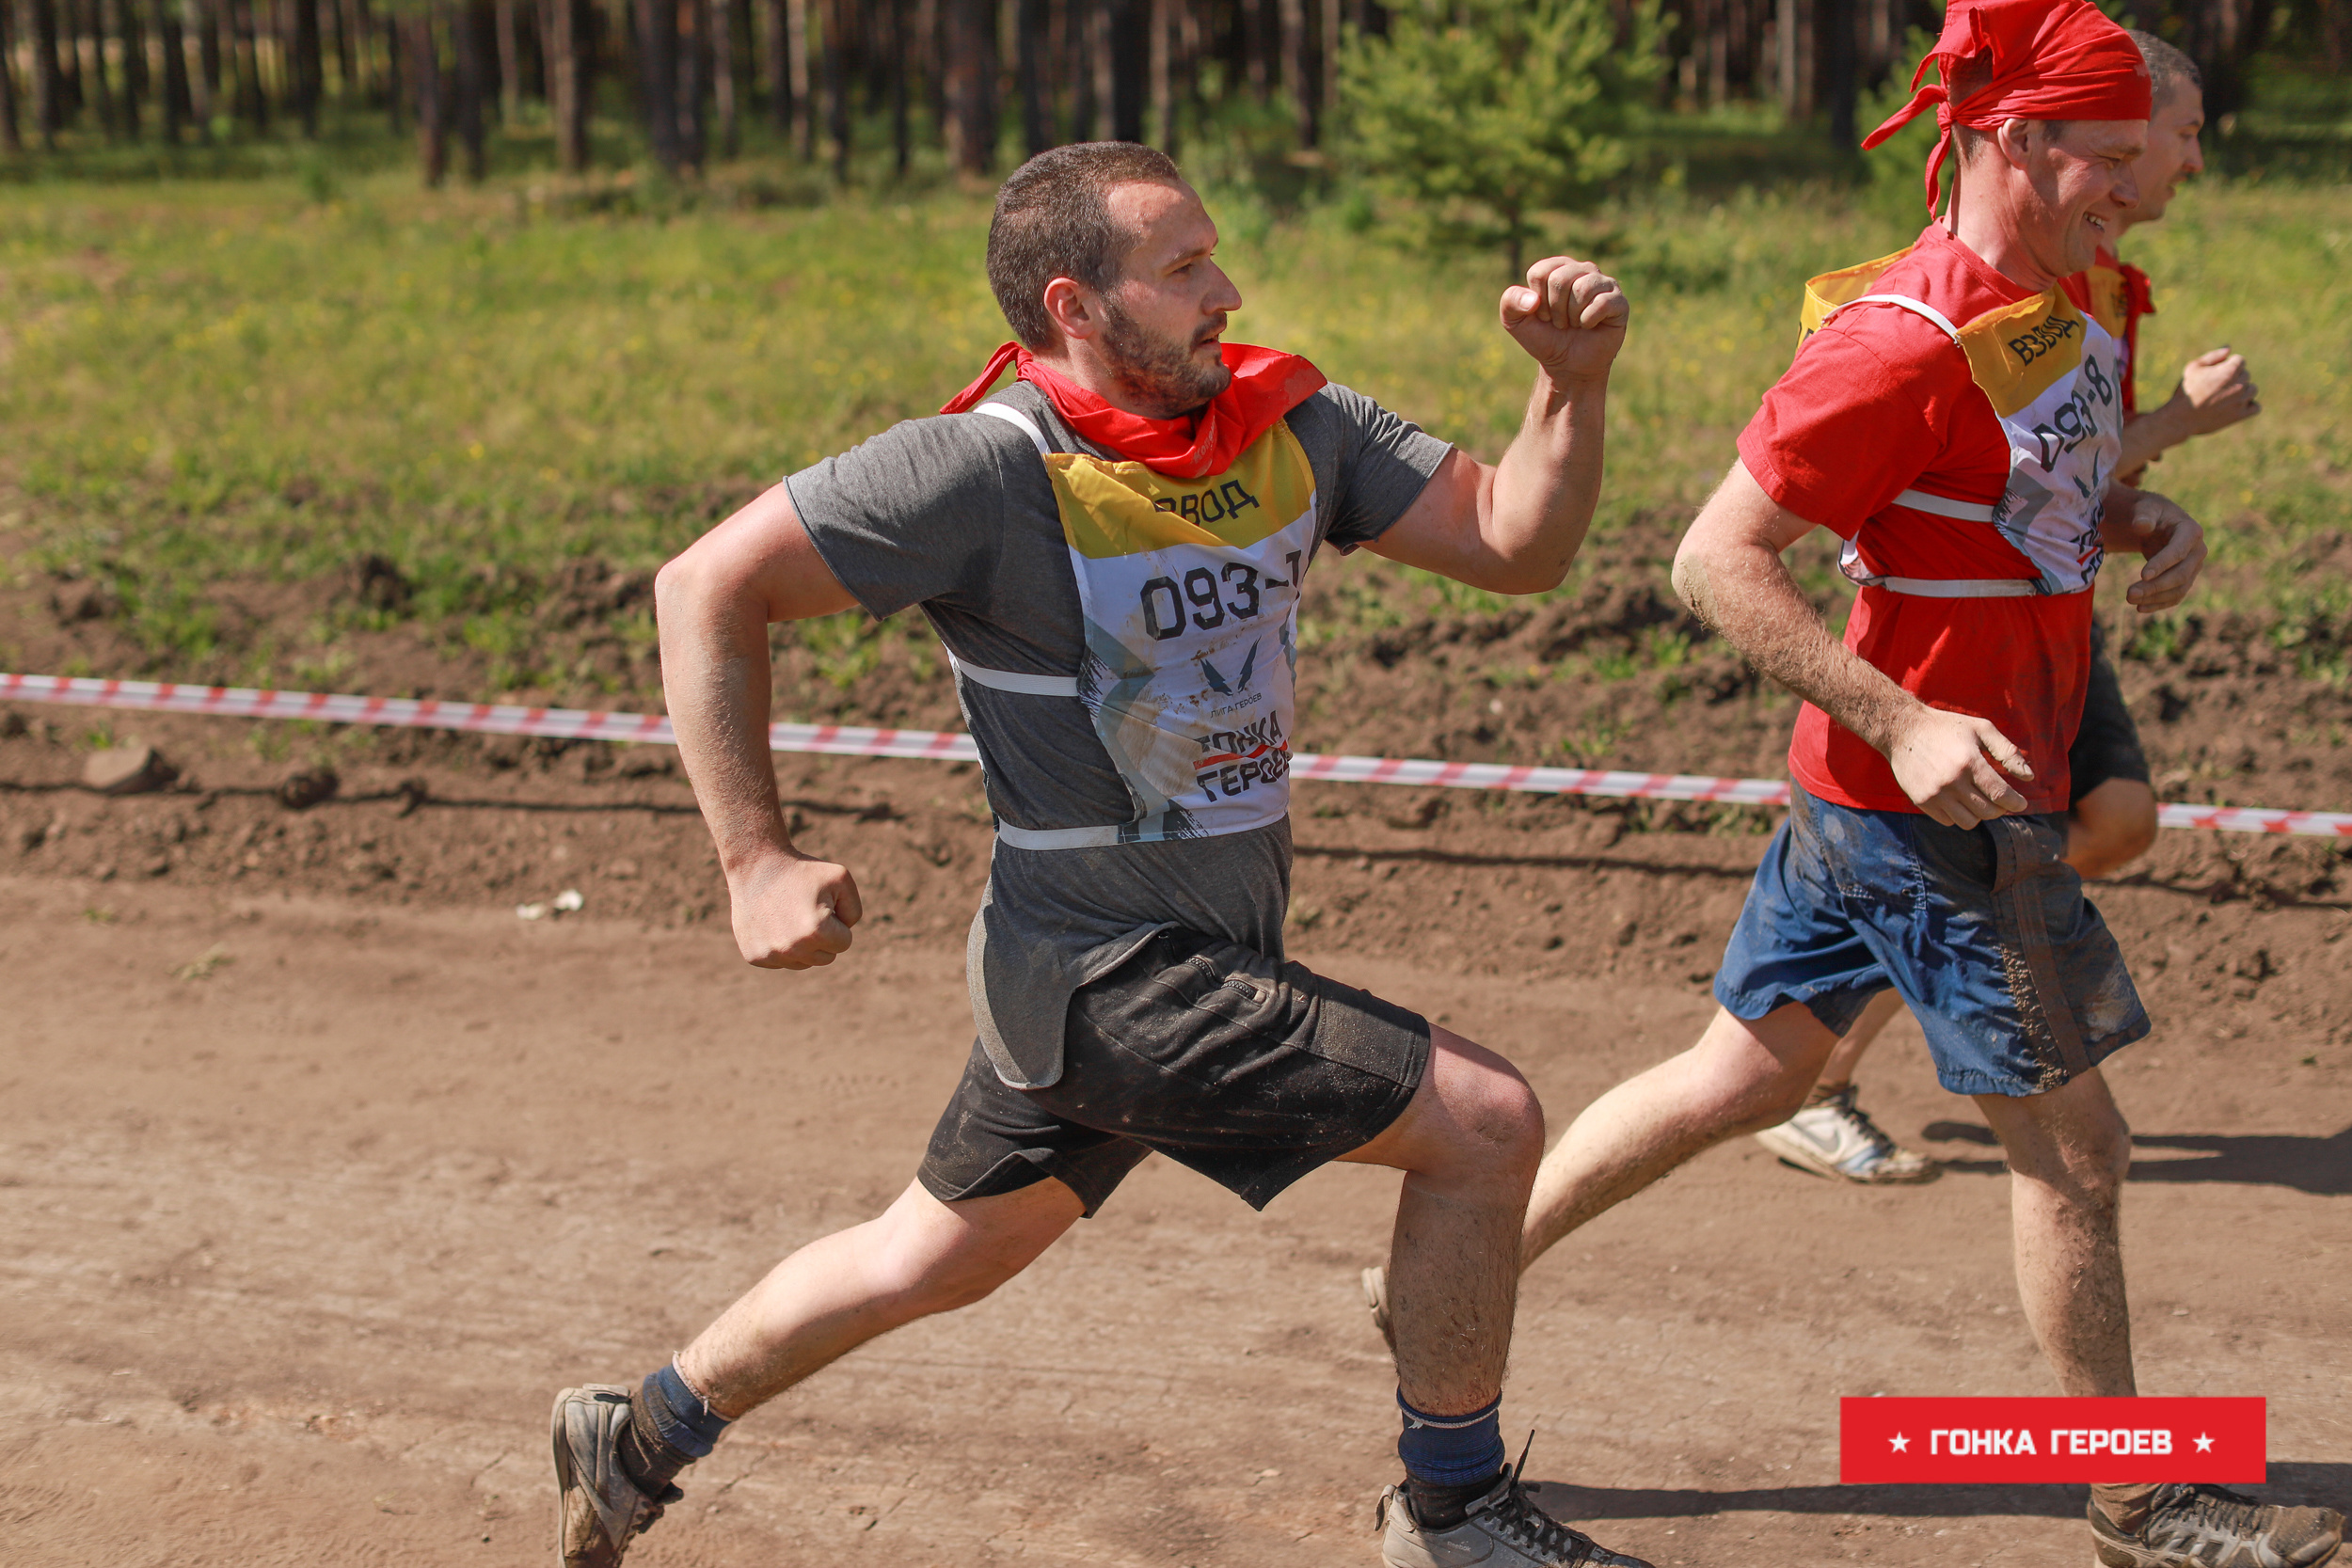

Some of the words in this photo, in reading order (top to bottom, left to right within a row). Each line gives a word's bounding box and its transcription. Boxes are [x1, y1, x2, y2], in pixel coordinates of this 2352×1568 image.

[2008, 315, 2079, 366] ВЗВОД
[2031, 354, 2112, 473] 093-8
[1210, 705, 1233, 719] ЛИГА
[1234, 692, 1263, 712] ГЕРОЕВ
